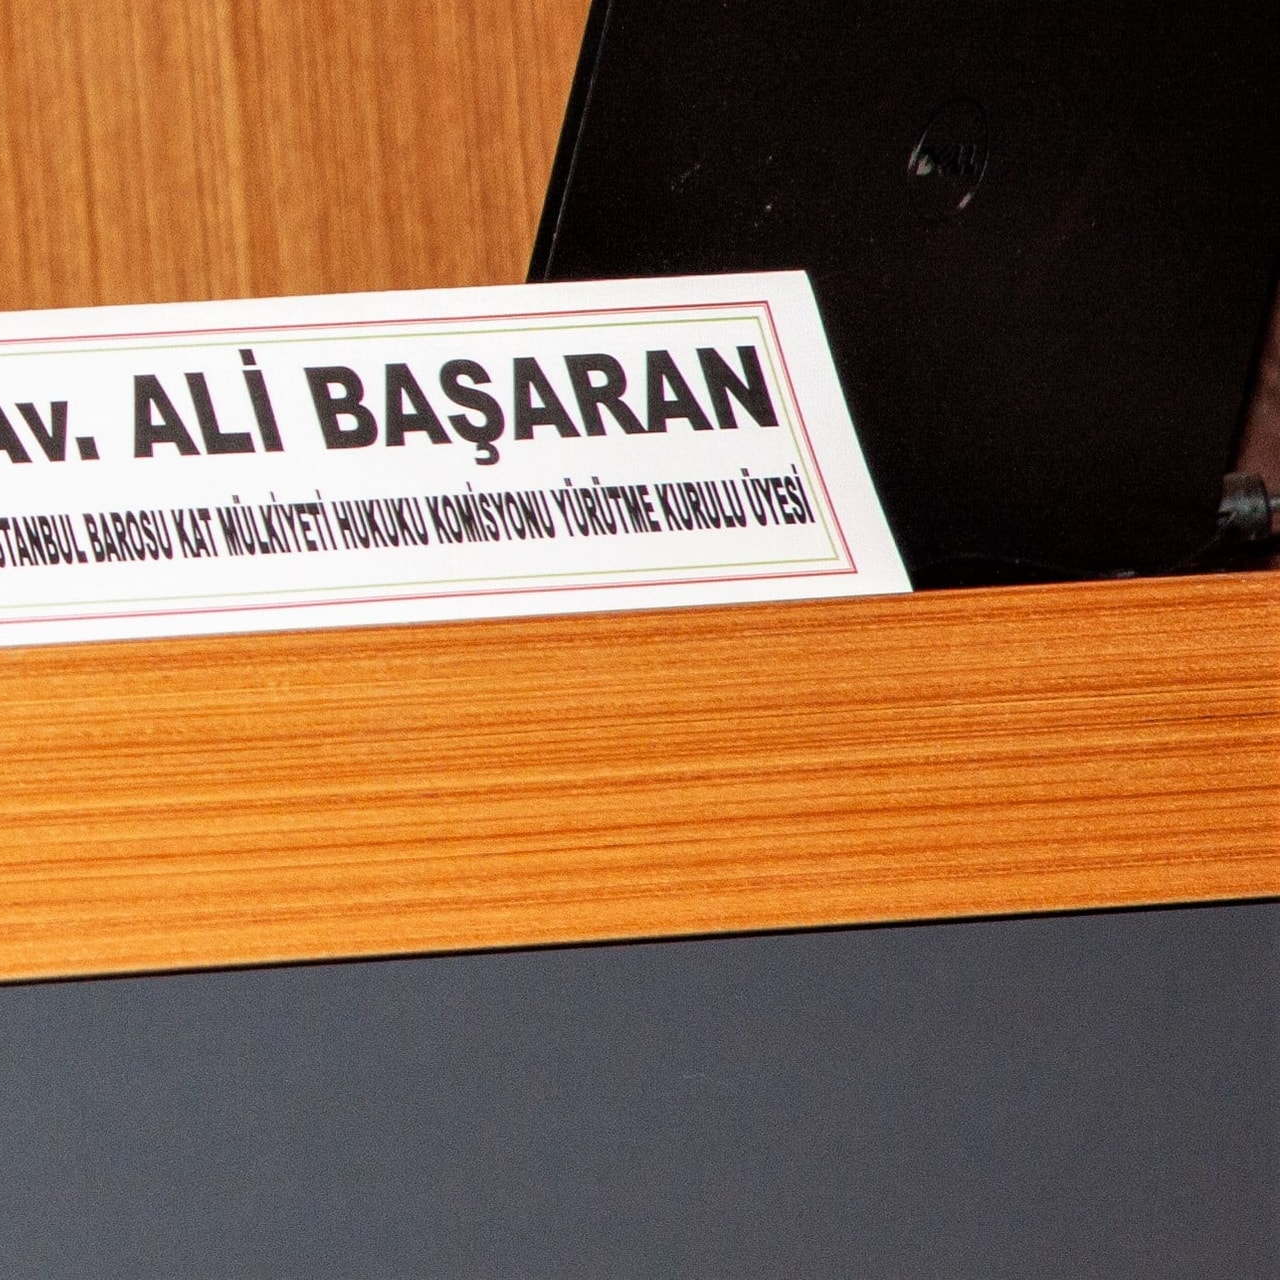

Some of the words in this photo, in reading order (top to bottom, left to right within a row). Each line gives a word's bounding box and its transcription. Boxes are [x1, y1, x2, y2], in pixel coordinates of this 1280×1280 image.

[133, 349, 285, 458] ALİ
[303, 345, 780, 466] BAŞARAN
[82, 510, 174, 563] BAROSU
[170, 508, 219, 559] KAT
[216, 489, 338, 557] MÜLKİYETİ
[331, 496, 429, 551] HUKUKU
[425, 481, 556, 544] KOMİSYONU
[550, 476, 663, 537] YÜRÜTME
[654, 479, 747, 532] KURULU
[740, 464, 817, 527] ÜYESİ
